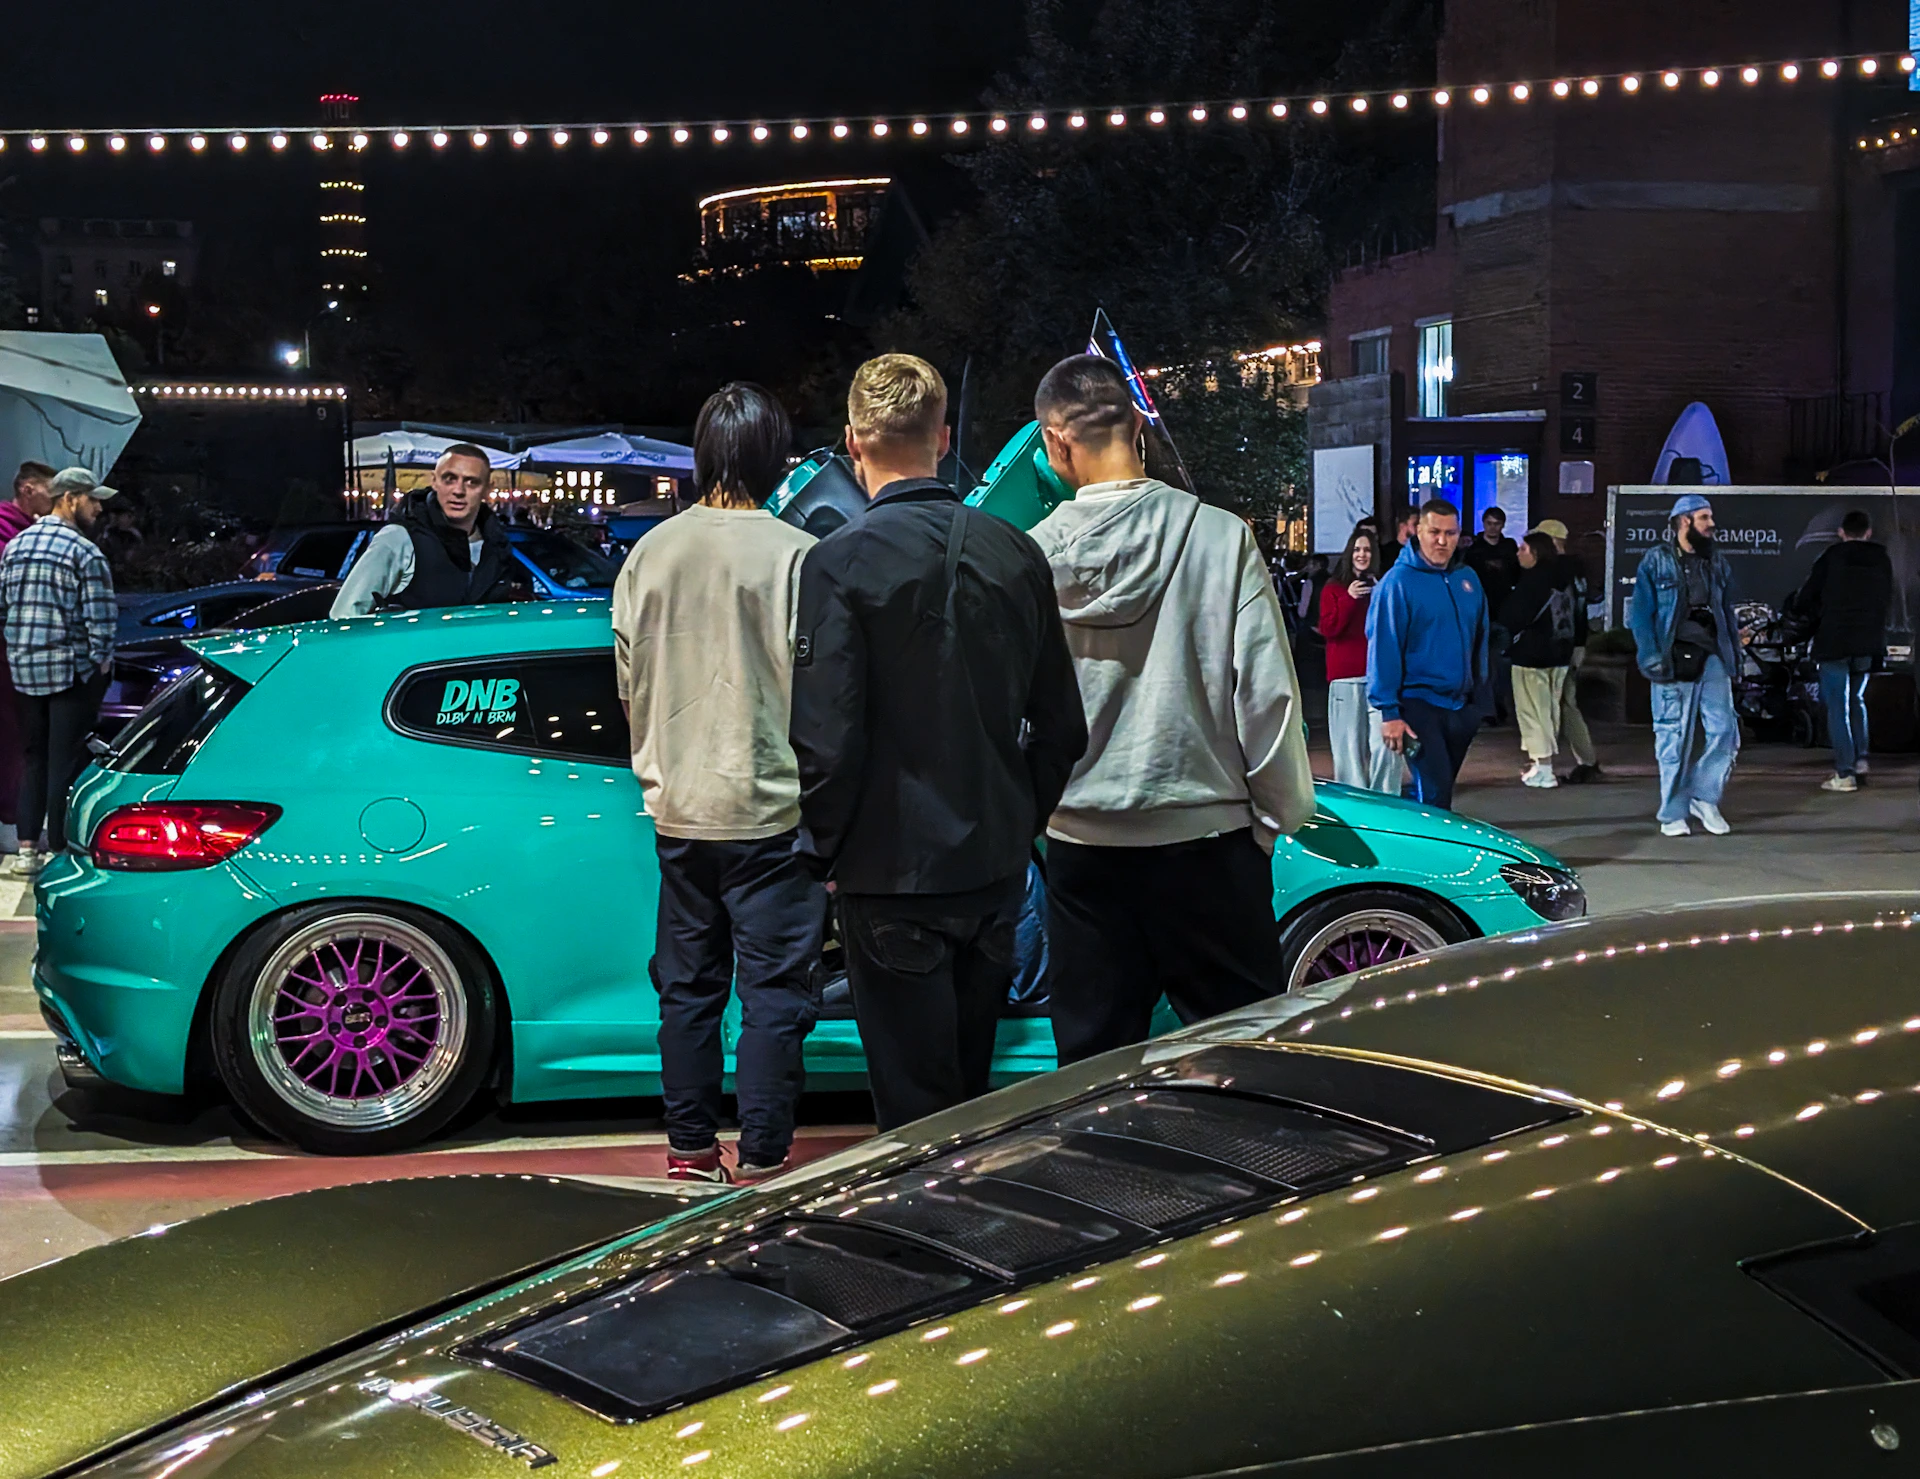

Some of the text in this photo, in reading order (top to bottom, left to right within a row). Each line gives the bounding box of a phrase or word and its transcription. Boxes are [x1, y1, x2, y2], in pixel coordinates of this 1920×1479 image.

[1572, 382, 1583, 399] 2
[317, 407, 327, 420] 9
[1572, 427, 1583, 443] 4
[1625, 528, 1657, 542] это
[441, 679, 520, 712] DNB
[487, 710, 517, 725] BRM
